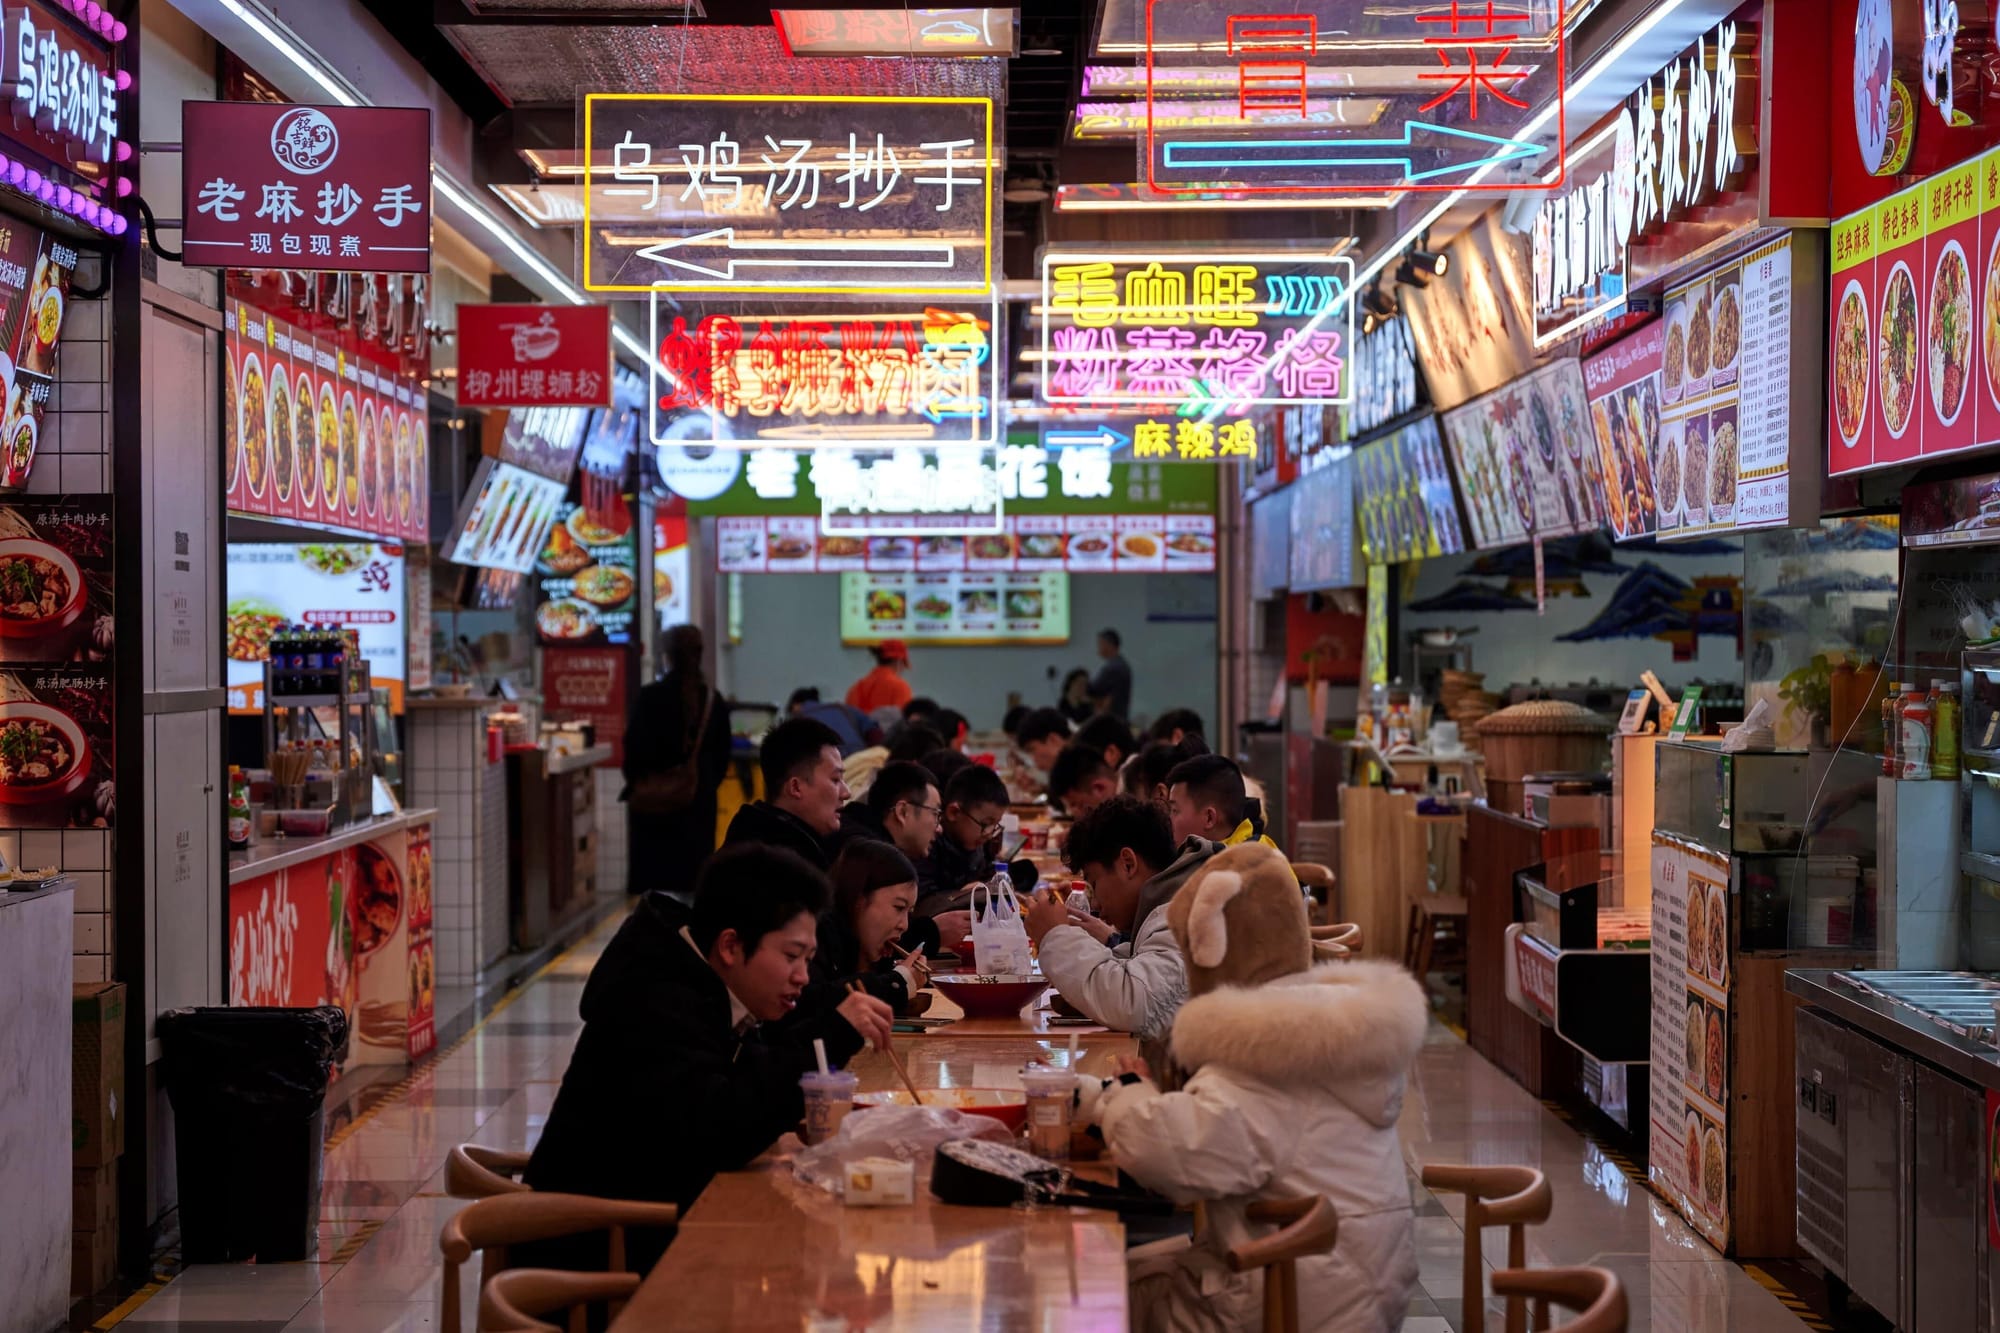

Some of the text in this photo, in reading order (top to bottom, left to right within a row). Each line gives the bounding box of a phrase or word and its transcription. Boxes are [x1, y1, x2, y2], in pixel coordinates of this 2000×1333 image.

[17, 6, 117, 163] 乌鸡汤抄手
[1227, 1, 1531, 120] 冒菜
[1635, 19, 1737, 235] 铁板炒饭
[603, 131, 983, 212] 乌鸡汤抄手
[197, 177, 422, 228] 老麻抄手
[1881, 197, 1919, 242] 特色香辣
[1931, 172, 1973, 222] 招牌干拌
[250, 233, 361, 257] 现包现煮
[1836, 218, 1870, 260] 经典麻辣
[1052, 263, 1258, 328] 毛血旺
[464, 367, 602, 400] 柳州螺蛳粉
[1053, 326, 1343, 398] 粉蒸格格
[1133, 418, 1258, 460] 麻辣鸡
[35, 512, 110, 528] 原汤牛肉抄手
[34, 676, 108, 691] 原汤肥肠抄手
